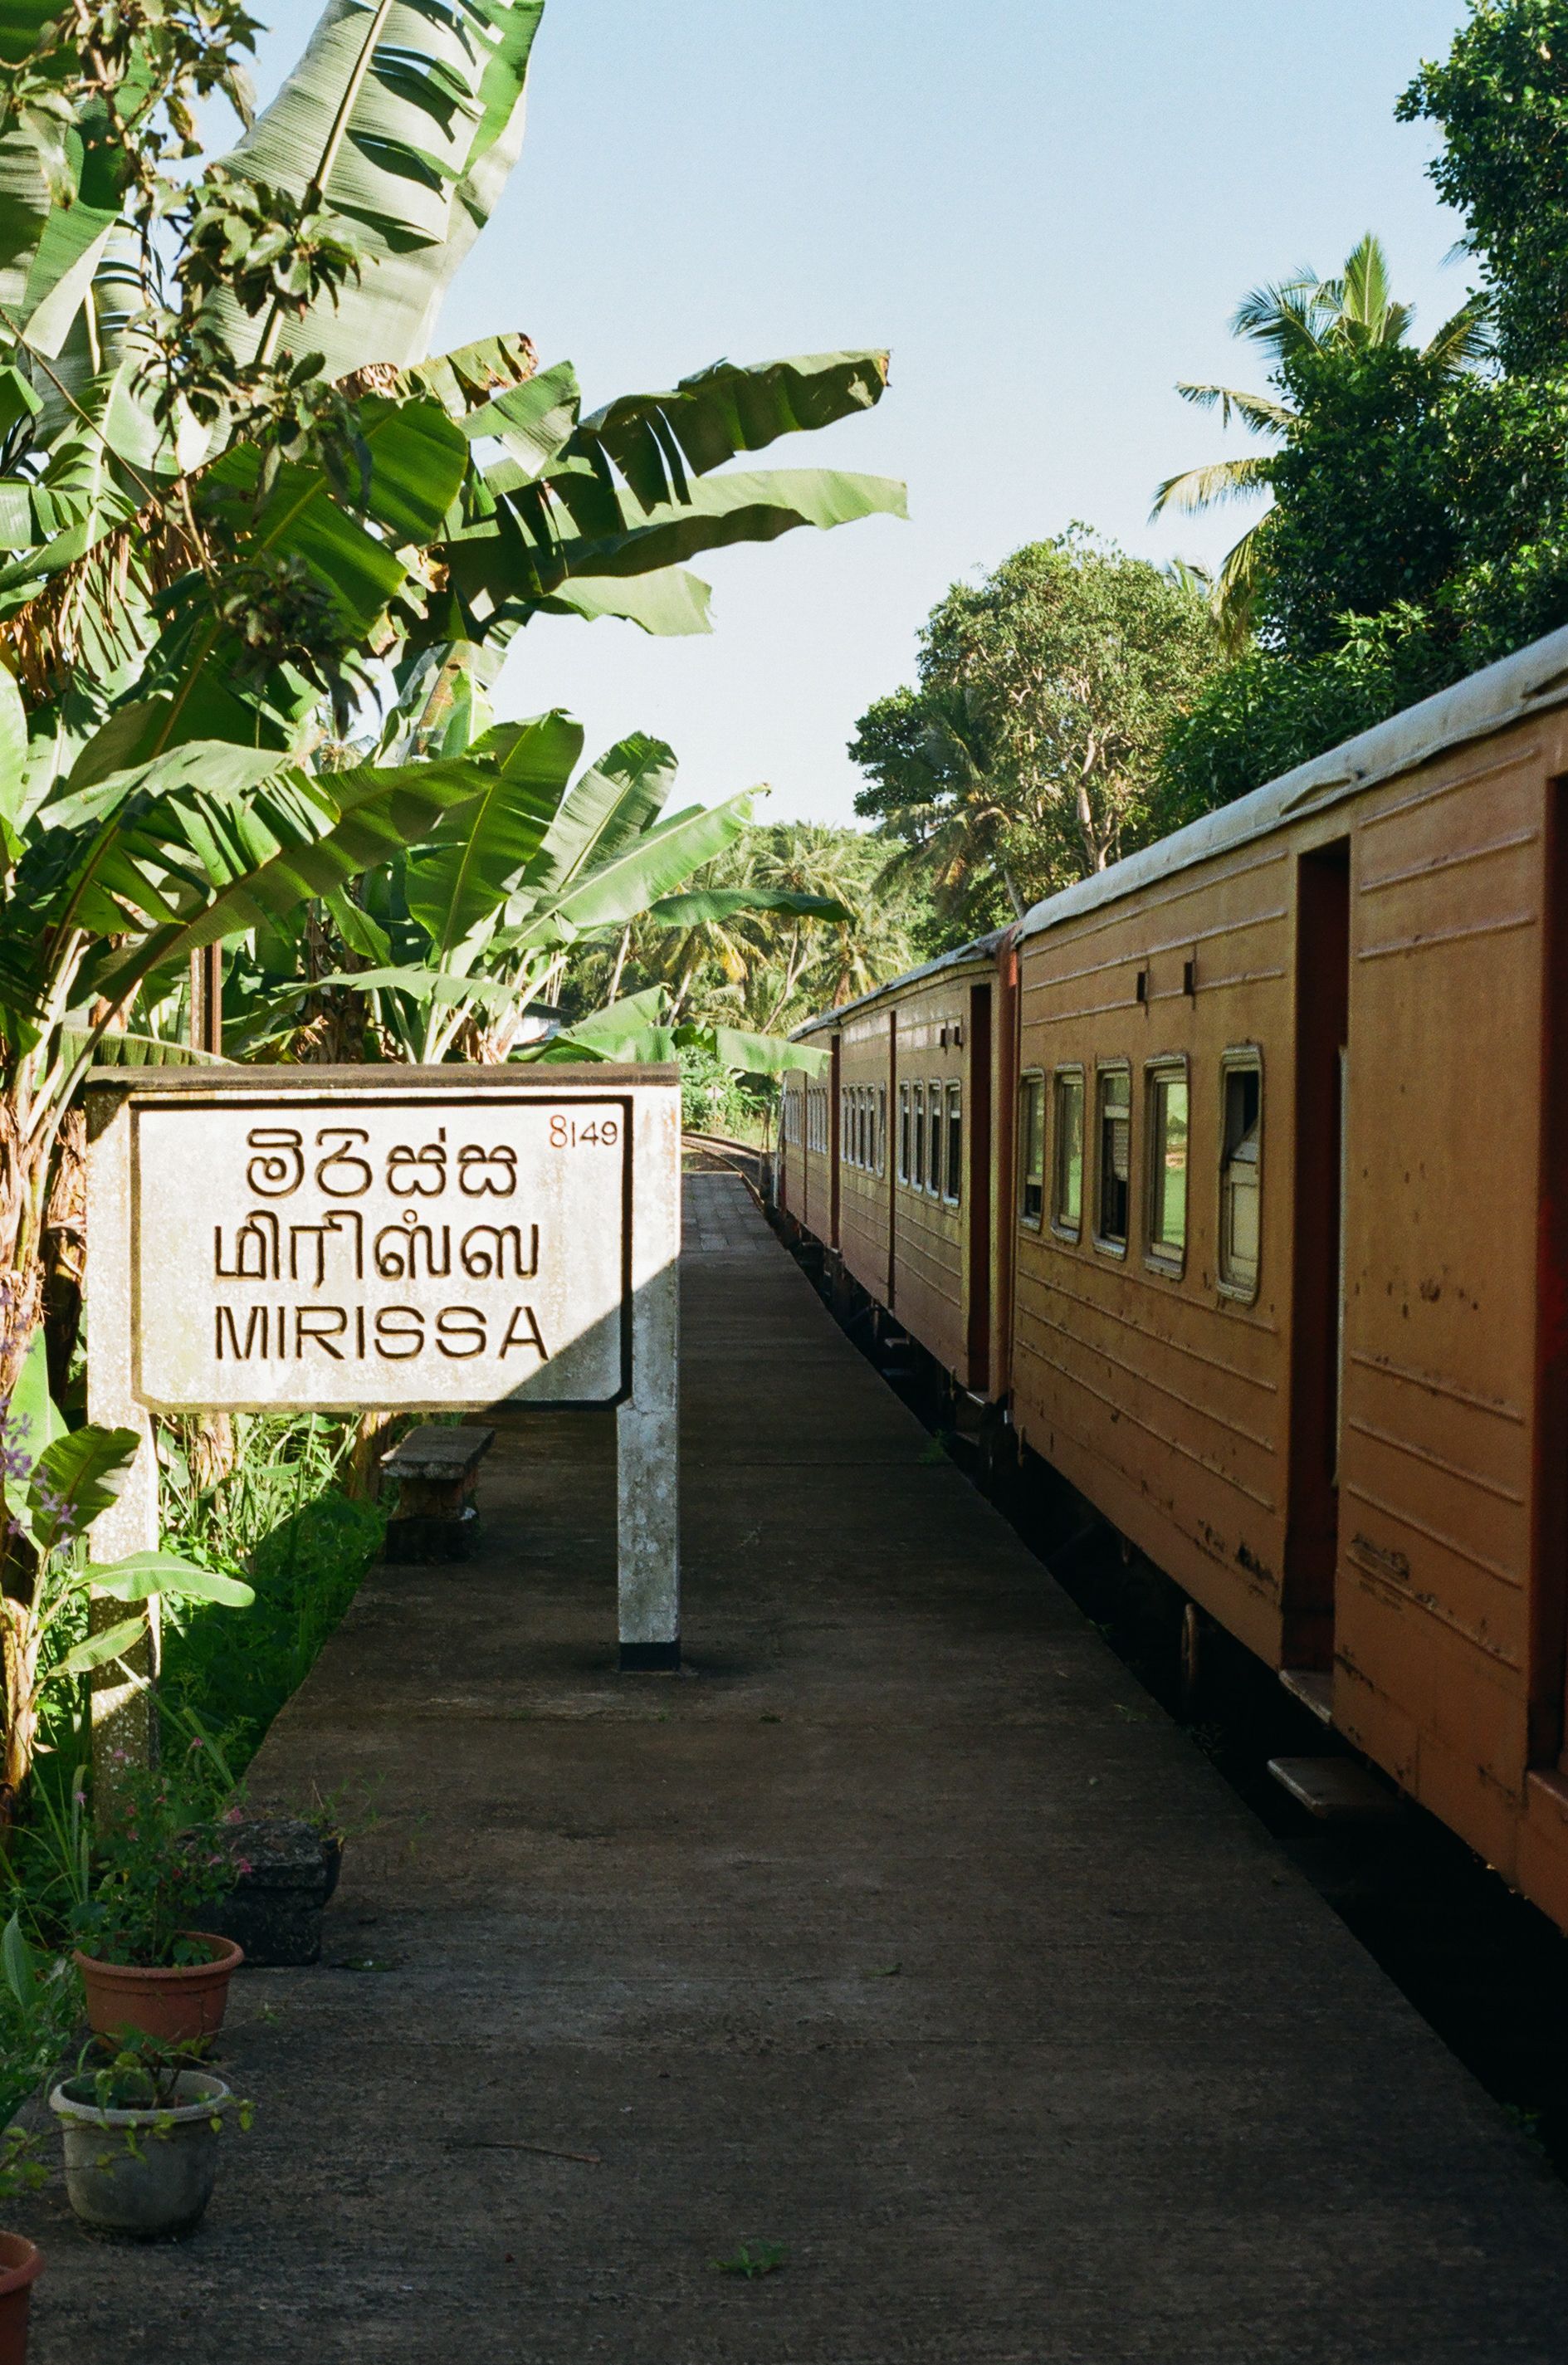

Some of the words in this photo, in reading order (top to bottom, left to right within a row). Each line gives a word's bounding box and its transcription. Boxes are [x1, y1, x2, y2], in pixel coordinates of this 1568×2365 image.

[247, 1127, 518, 1198] මිරිස්ස
[550, 1114, 618, 1148] 8149
[213, 1209, 540, 1289] மிரிஸ்ஸ
[215, 1306, 550, 1361] MIRISSA
